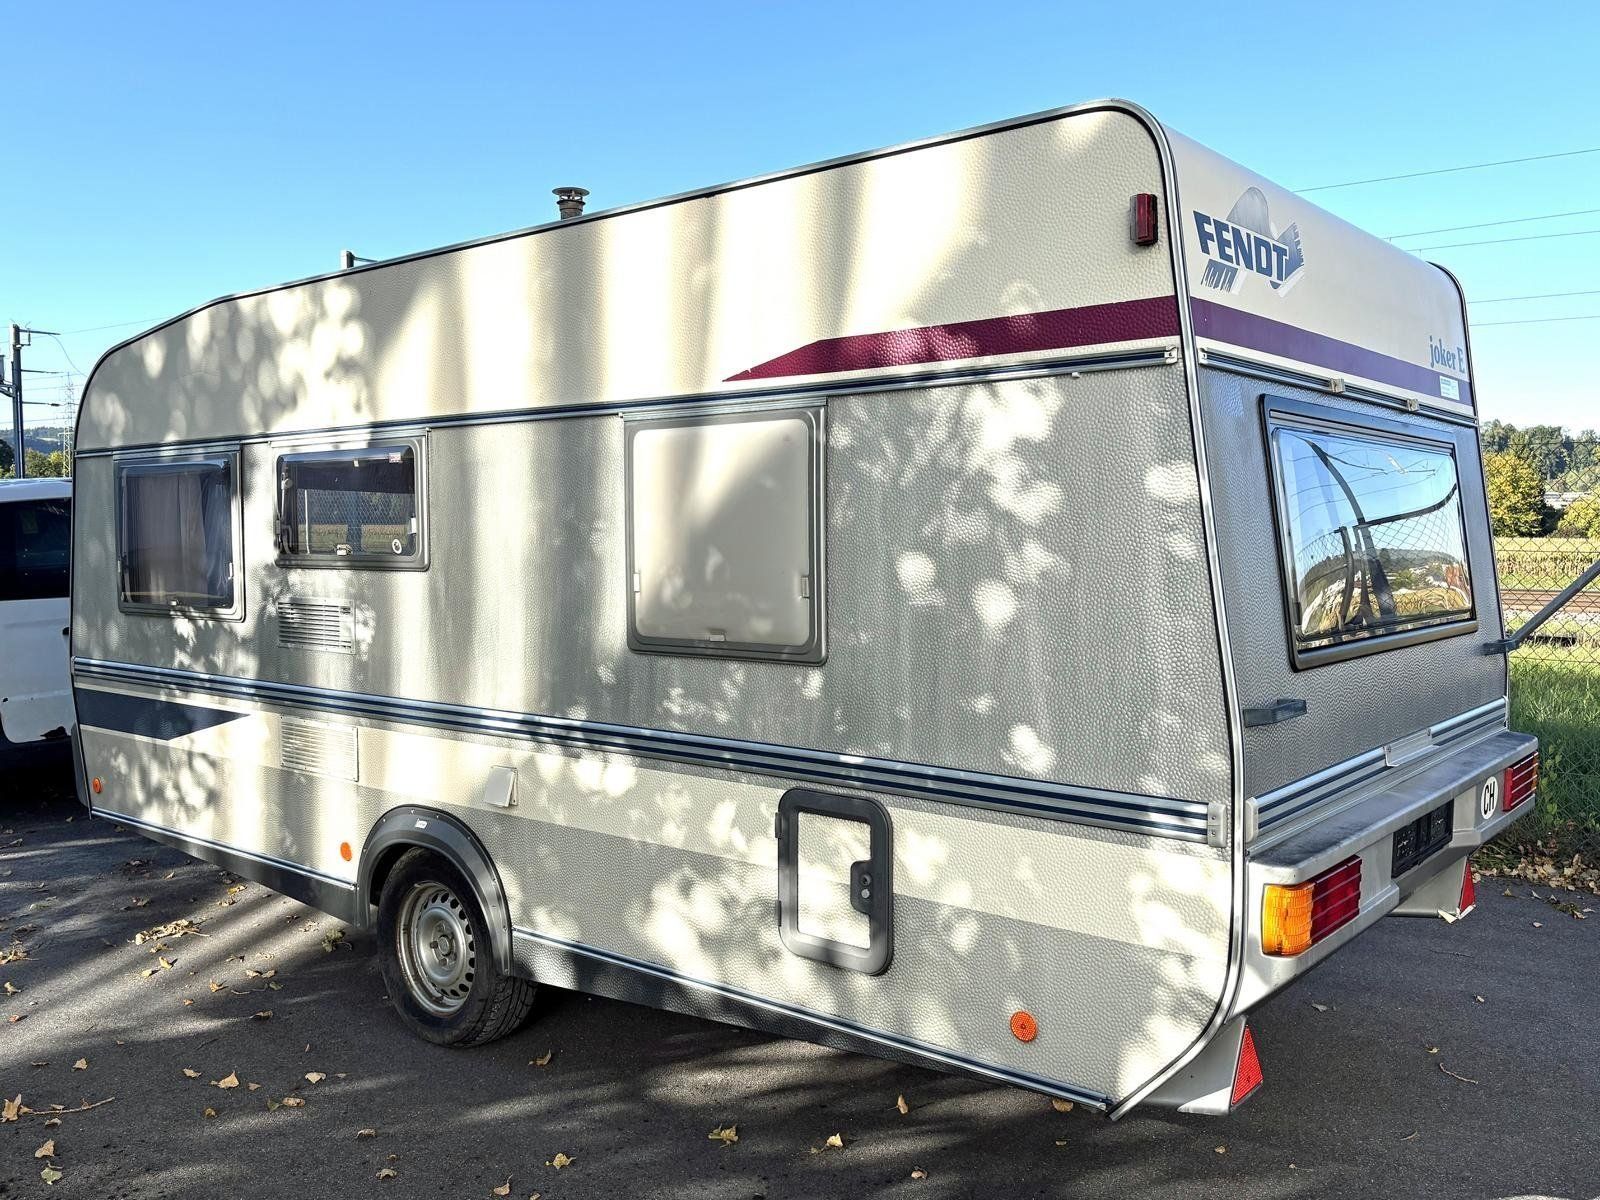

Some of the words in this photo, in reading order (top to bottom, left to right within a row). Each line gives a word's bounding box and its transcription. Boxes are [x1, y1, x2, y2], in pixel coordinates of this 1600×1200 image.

[1193, 210, 1288, 282] FENDT
[1429, 335, 1456, 370] joker
[1457, 347, 1465, 373] E
[1484, 781, 1496, 816] CH
